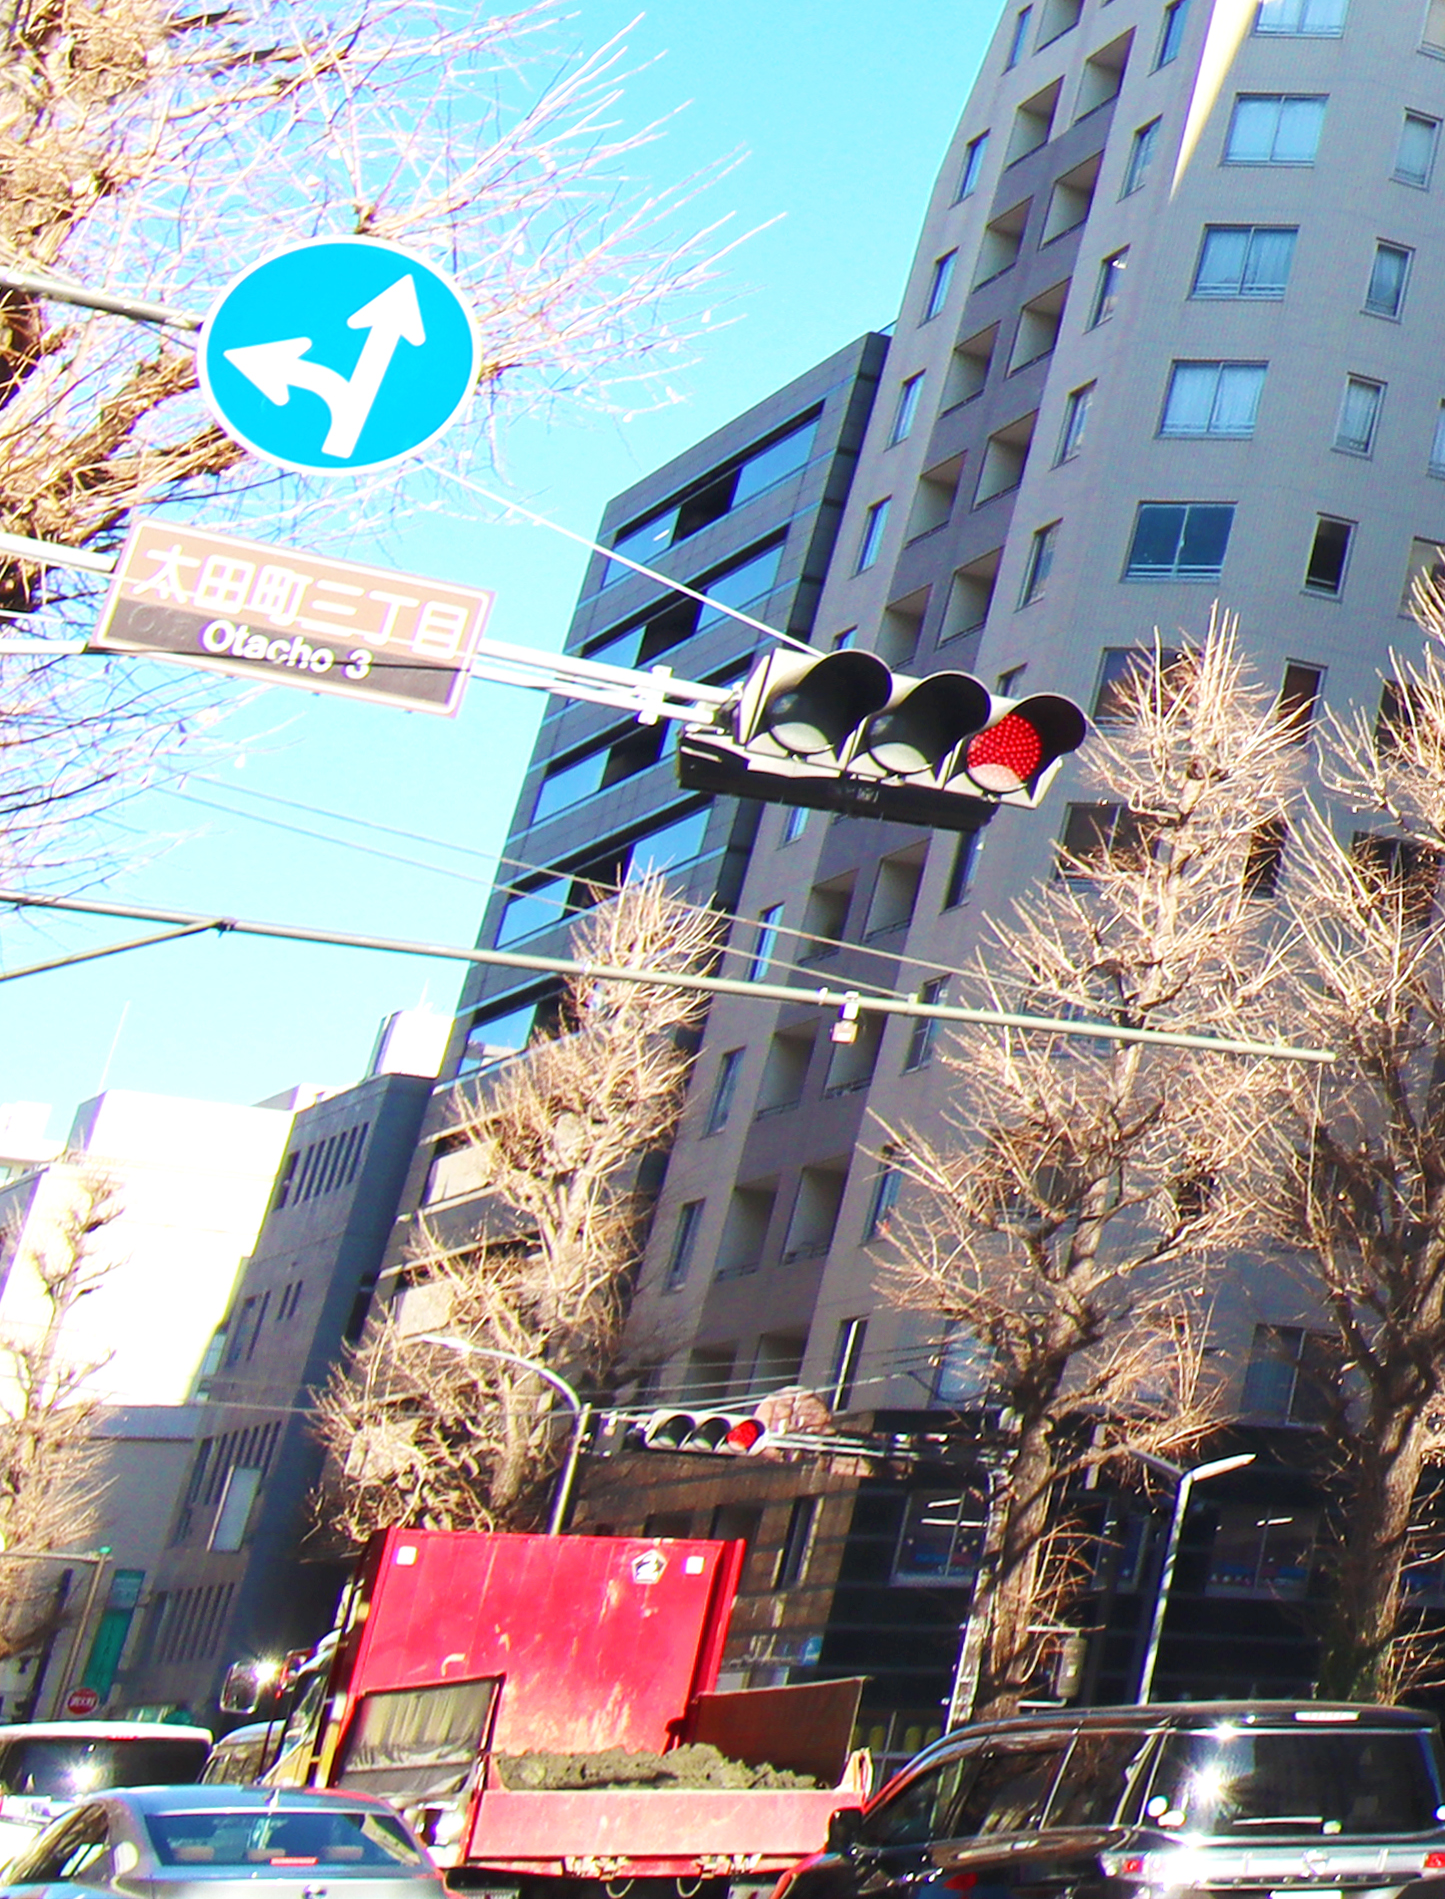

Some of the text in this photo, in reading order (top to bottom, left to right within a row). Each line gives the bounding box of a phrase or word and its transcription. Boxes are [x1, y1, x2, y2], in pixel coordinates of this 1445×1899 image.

[133, 544, 469, 659] 太田町三丁目
[203, 619, 336, 674] Otacho
[342, 648, 374, 680] 3
